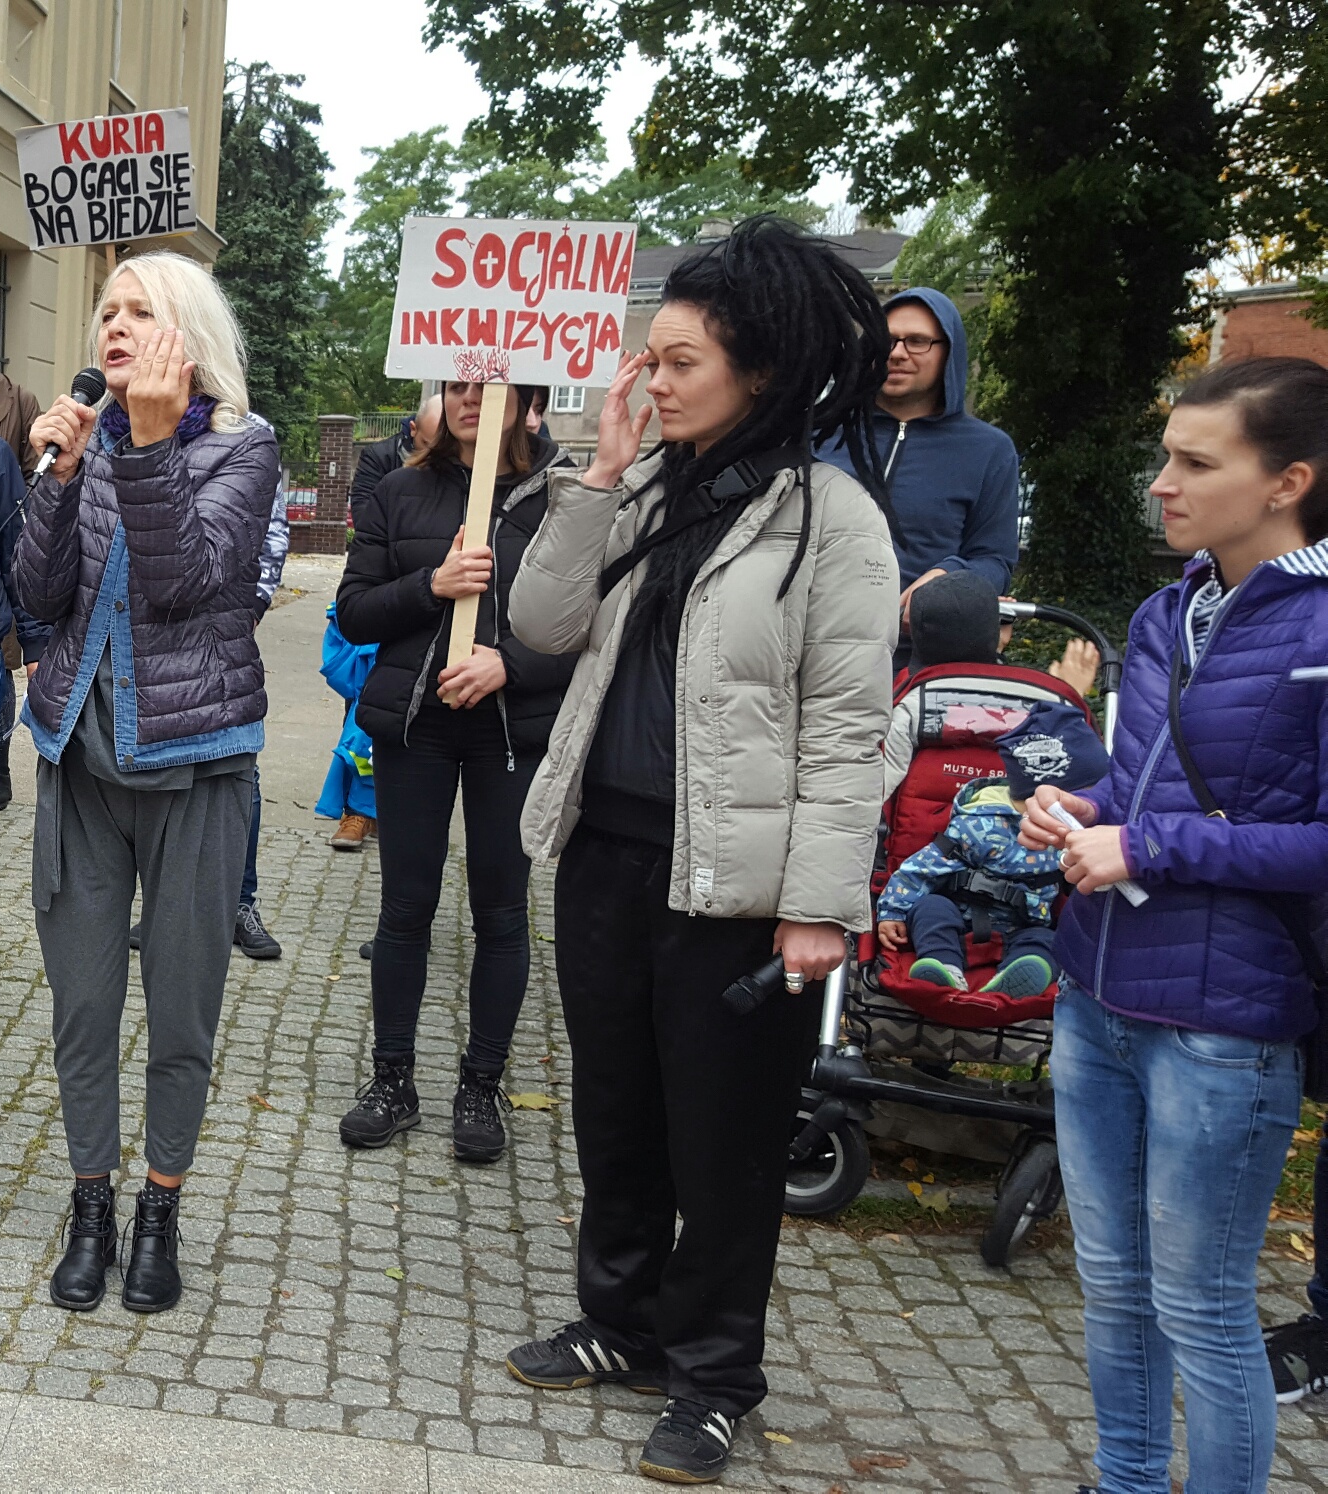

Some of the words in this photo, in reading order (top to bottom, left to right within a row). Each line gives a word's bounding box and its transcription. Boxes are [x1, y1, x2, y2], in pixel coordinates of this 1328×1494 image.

[58, 113, 165, 164] KURIA
[24, 158, 139, 208] BOGACI
[146, 152, 190, 191] SIĘ
[30, 205, 79, 247] NA
[87, 191, 196, 242] BIEDZIE
[431, 223, 635, 309] SOCJALNA
[400, 308, 622, 379] INKWIZYCJA
[943, 763, 983, 777] MUTSY
[988, 769, 1007, 778] SP
